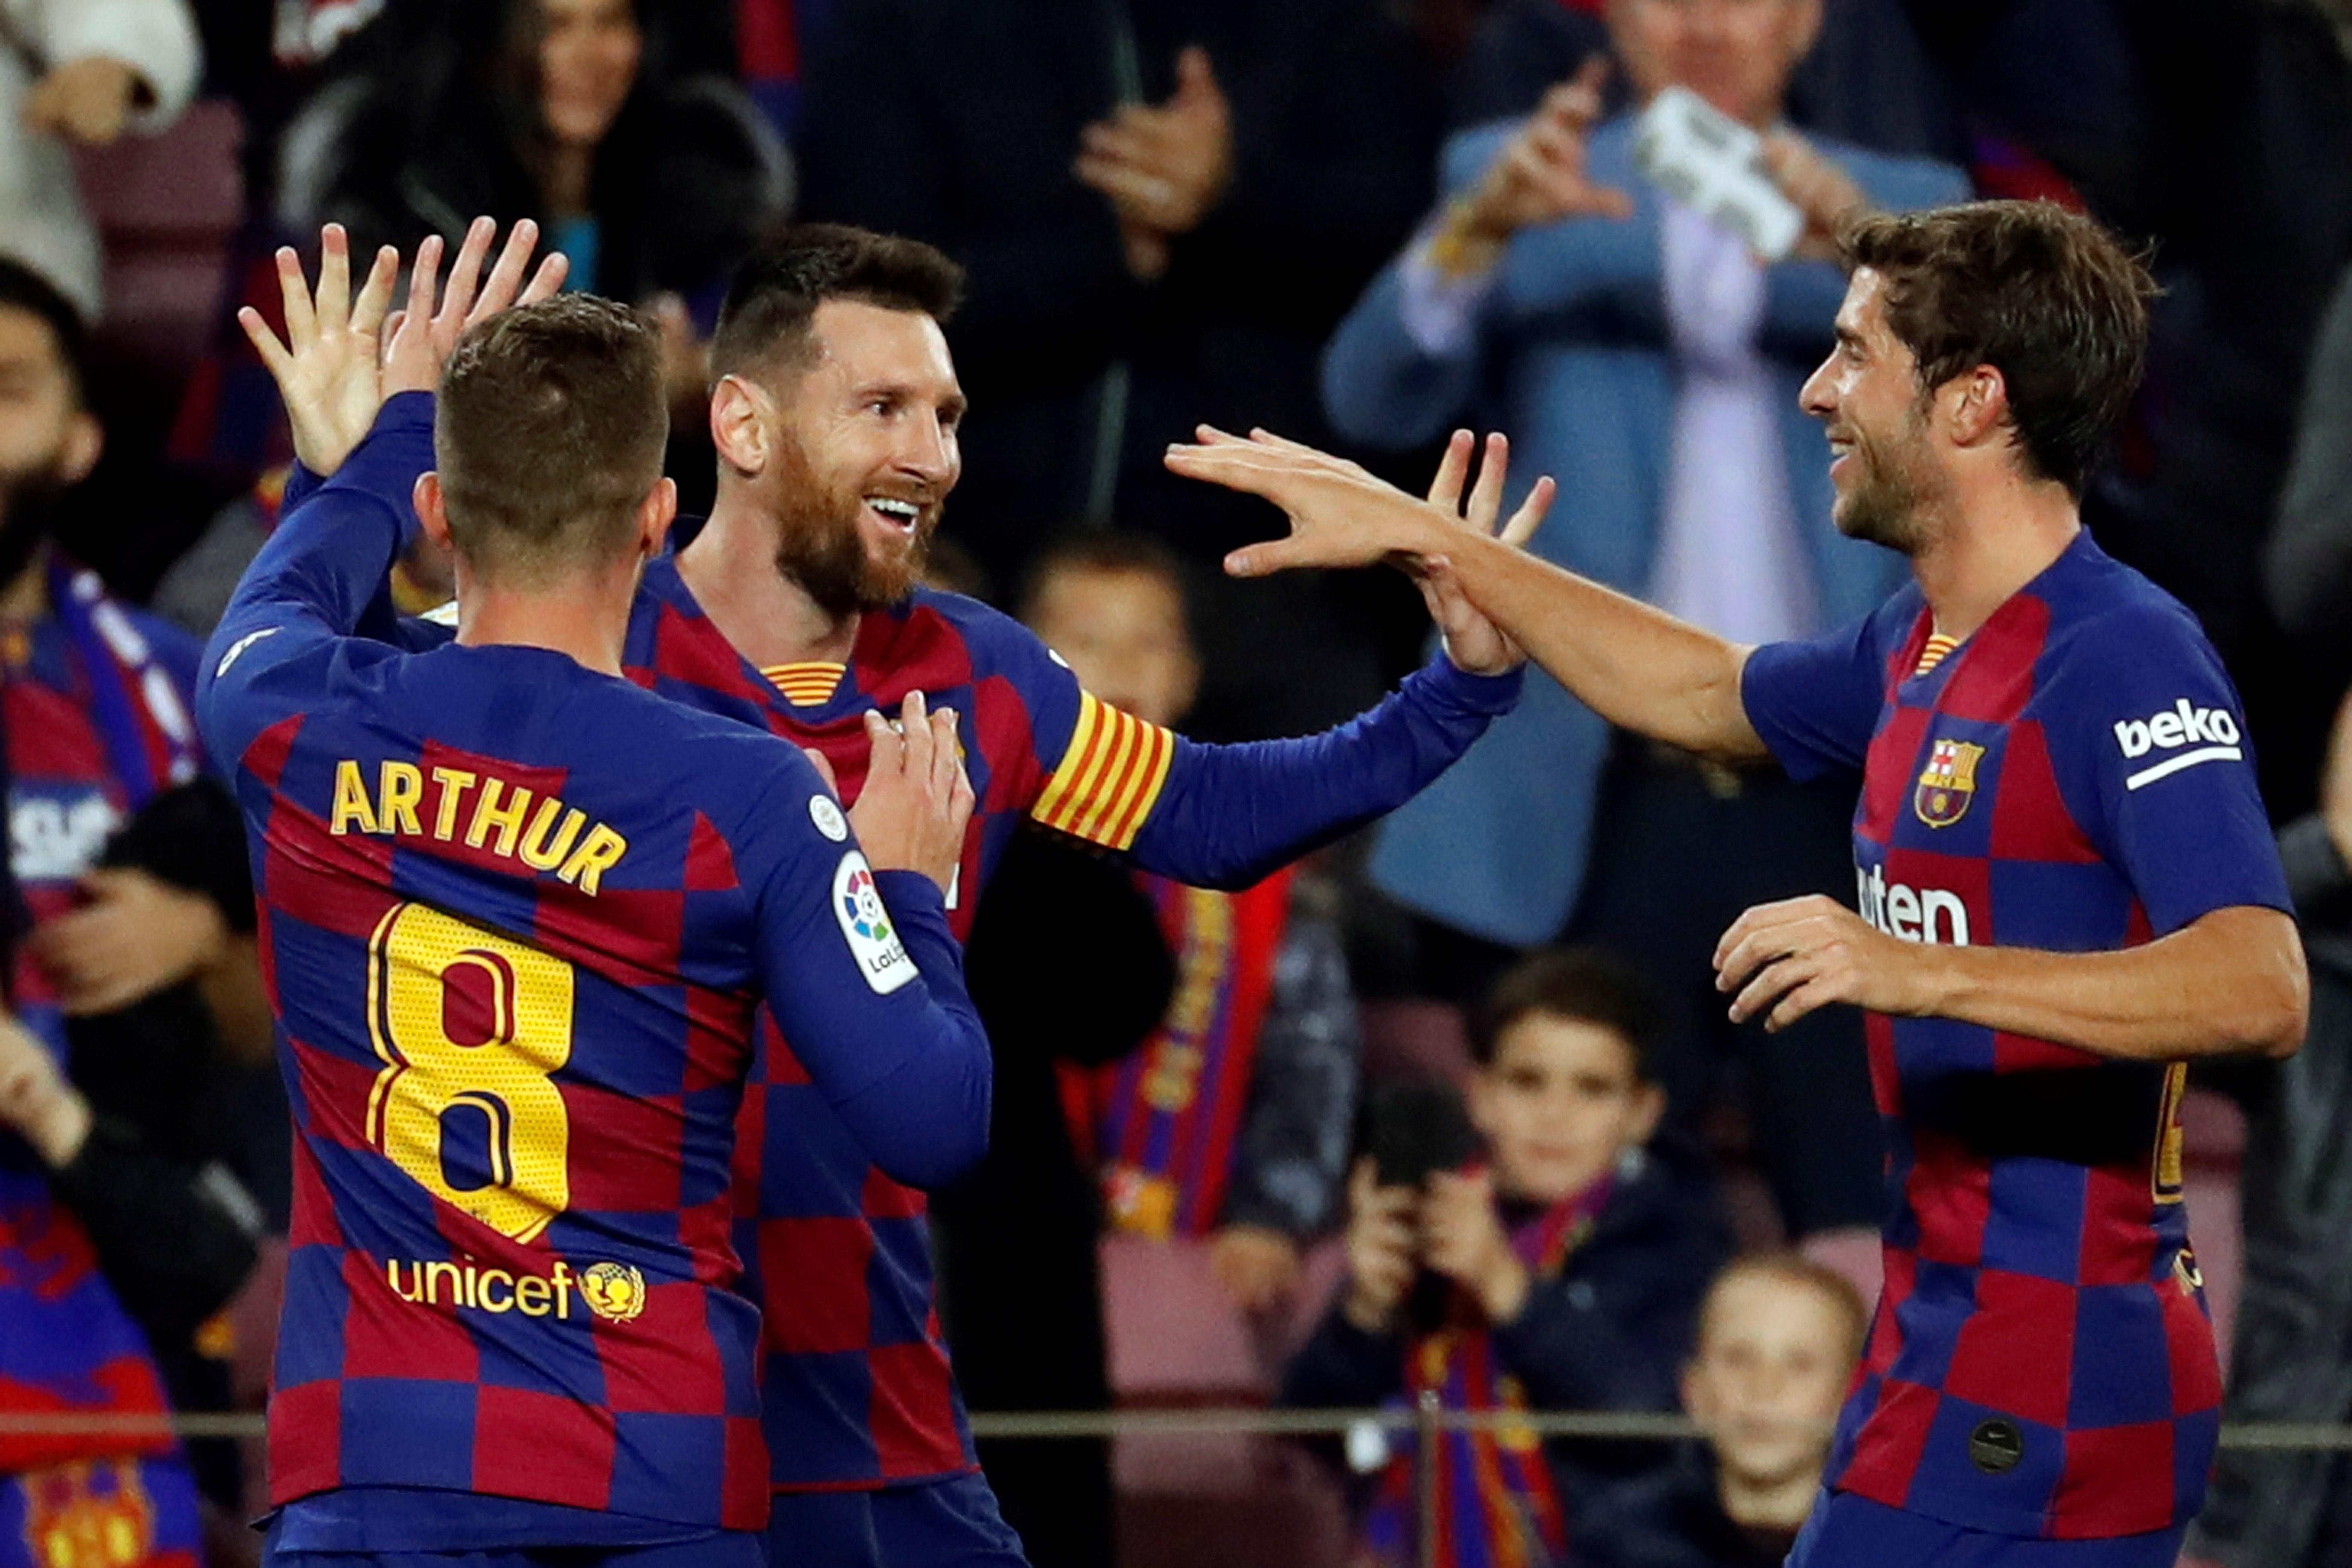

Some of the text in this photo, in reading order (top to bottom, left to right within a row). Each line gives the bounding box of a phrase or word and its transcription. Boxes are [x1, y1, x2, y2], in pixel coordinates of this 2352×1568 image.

[2113, 698, 2241, 759] beko
[330, 760, 628, 897] ARTHUR
[365, 901, 576, 1244] 8
[388, 1253, 573, 1320] unicef
